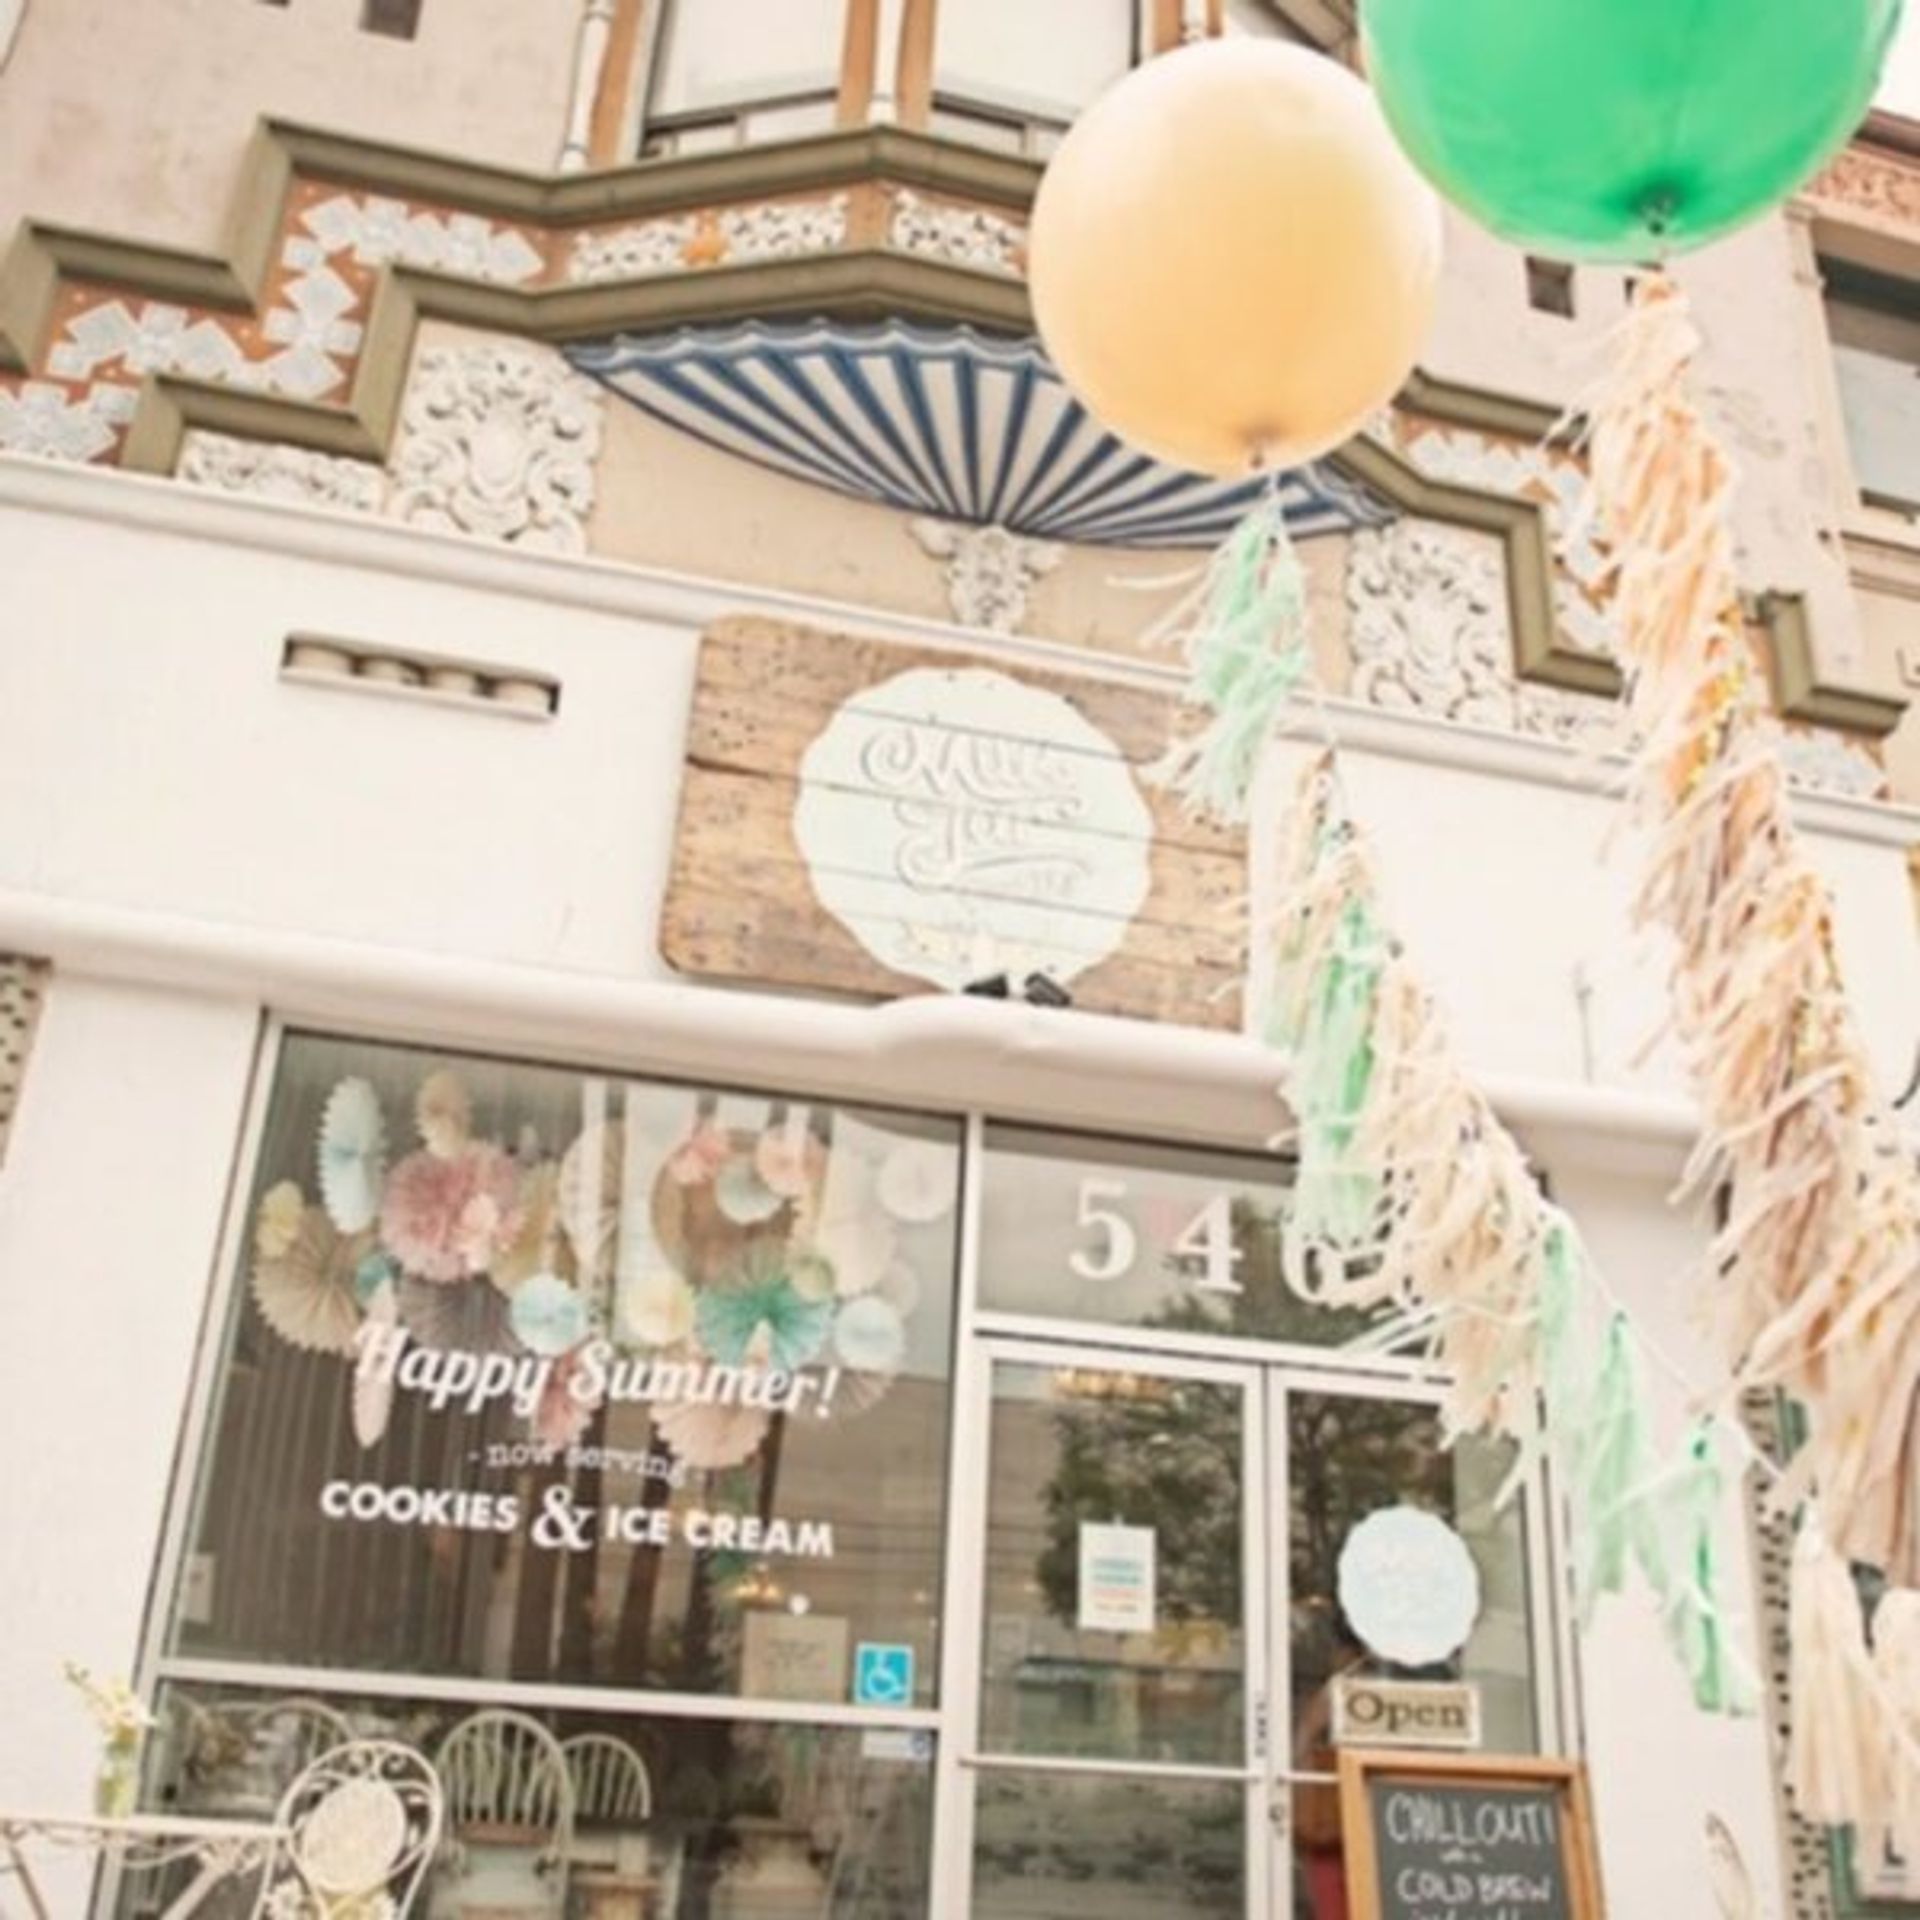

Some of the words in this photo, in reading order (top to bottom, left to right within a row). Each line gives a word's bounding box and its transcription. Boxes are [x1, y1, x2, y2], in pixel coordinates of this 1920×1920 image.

[353, 1324, 553, 1418] Happy
[567, 1338, 840, 1418] Summer!
[485, 1442, 555, 1468] now
[565, 1446, 688, 1489] serving
[320, 1481, 520, 1531] COOKIES
[531, 1484, 598, 1551] &
[606, 1506, 671, 1545] ICE
[686, 1509, 836, 1558] CREAM
[1345, 1689, 1468, 1733] Open
[1397, 1868, 1475, 1904] COLD
[1477, 1872, 1552, 1905] BREW
